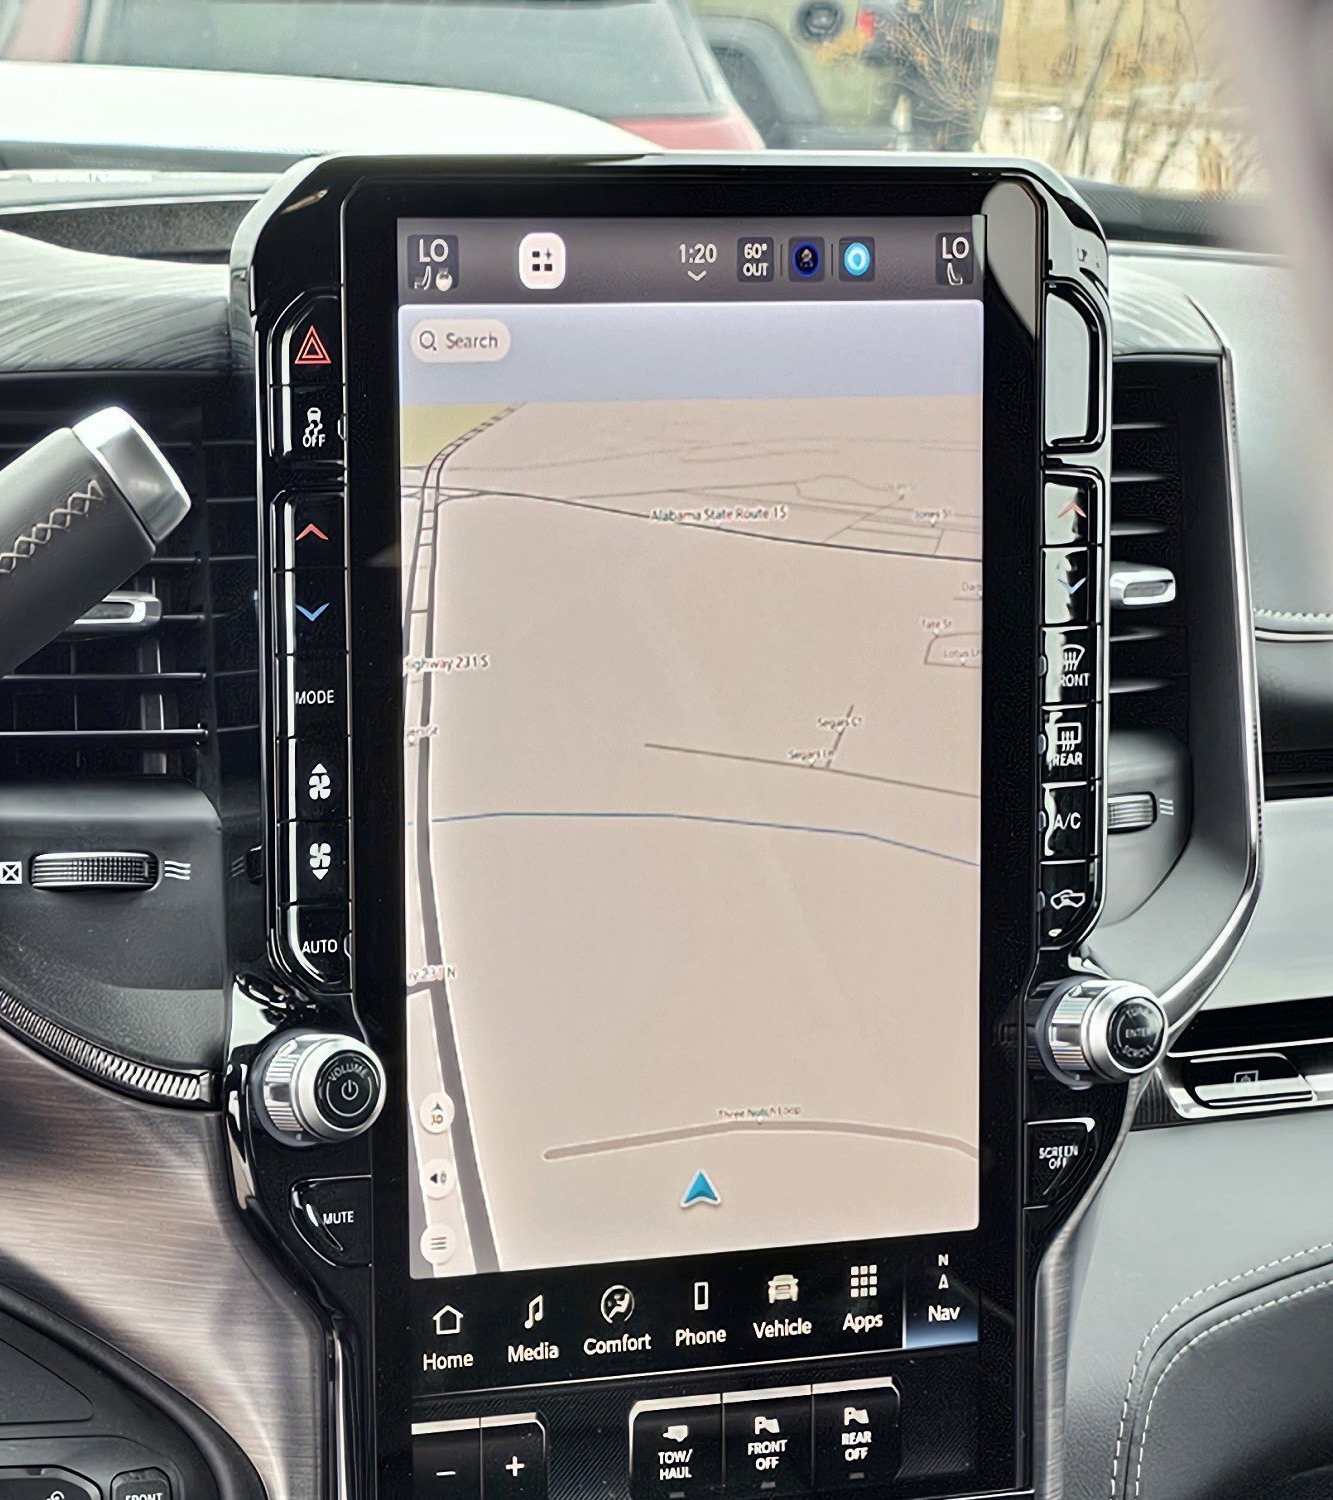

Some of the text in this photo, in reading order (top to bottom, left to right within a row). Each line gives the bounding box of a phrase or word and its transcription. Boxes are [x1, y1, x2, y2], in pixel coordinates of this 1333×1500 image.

[419, 238, 449, 263] LO
[679, 243, 718, 264] 1:20
[942, 236, 970, 260] LO
[743, 263, 768, 277] OUT
[445, 331, 499, 350] Search
[302, 433, 326, 449] OFF
[651, 509, 702, 522] Alabama
[704, 507, 733, 520] State
[735, 507, 770, 520] Route
[1055, 671, 1091, 687] RONT
[294, 689, 335, 706] MODE
[1052, 751, 1083, 767] REAR
[1053, 812, 1082, 830] A/C
[301, 938, 338, 955] AUTO
[327, 1062, 370, 1083] VOLUME
[1038, 1144, 1079, 1160] SCREEN
[1048, 1156, 1067, 1170] OFF
[322, 1210, 355, 1225] MUTE
[928, 1304, 961, 1323] Nav
[752, 1317, 813, 1340] Vehicle
[842, 1312, 884, 1334] Apps
[583, 1332, 652, 1356] Comfort
[675, 1326, 727, 1347] Phone
[422, 1351, 475, 1372] Home
[507, 1341, 560, 1364] Media
[747, 1438, 788, 1456] FRONT
[841, 1430, 872, 1446] REAR
[658, 1448, 693, 1466] TOW/
[755, 1455, 780, 1471] OFF
[844, 1446, 869, 1462] OFF
[659, 1465, 693, 1481] HAUL
